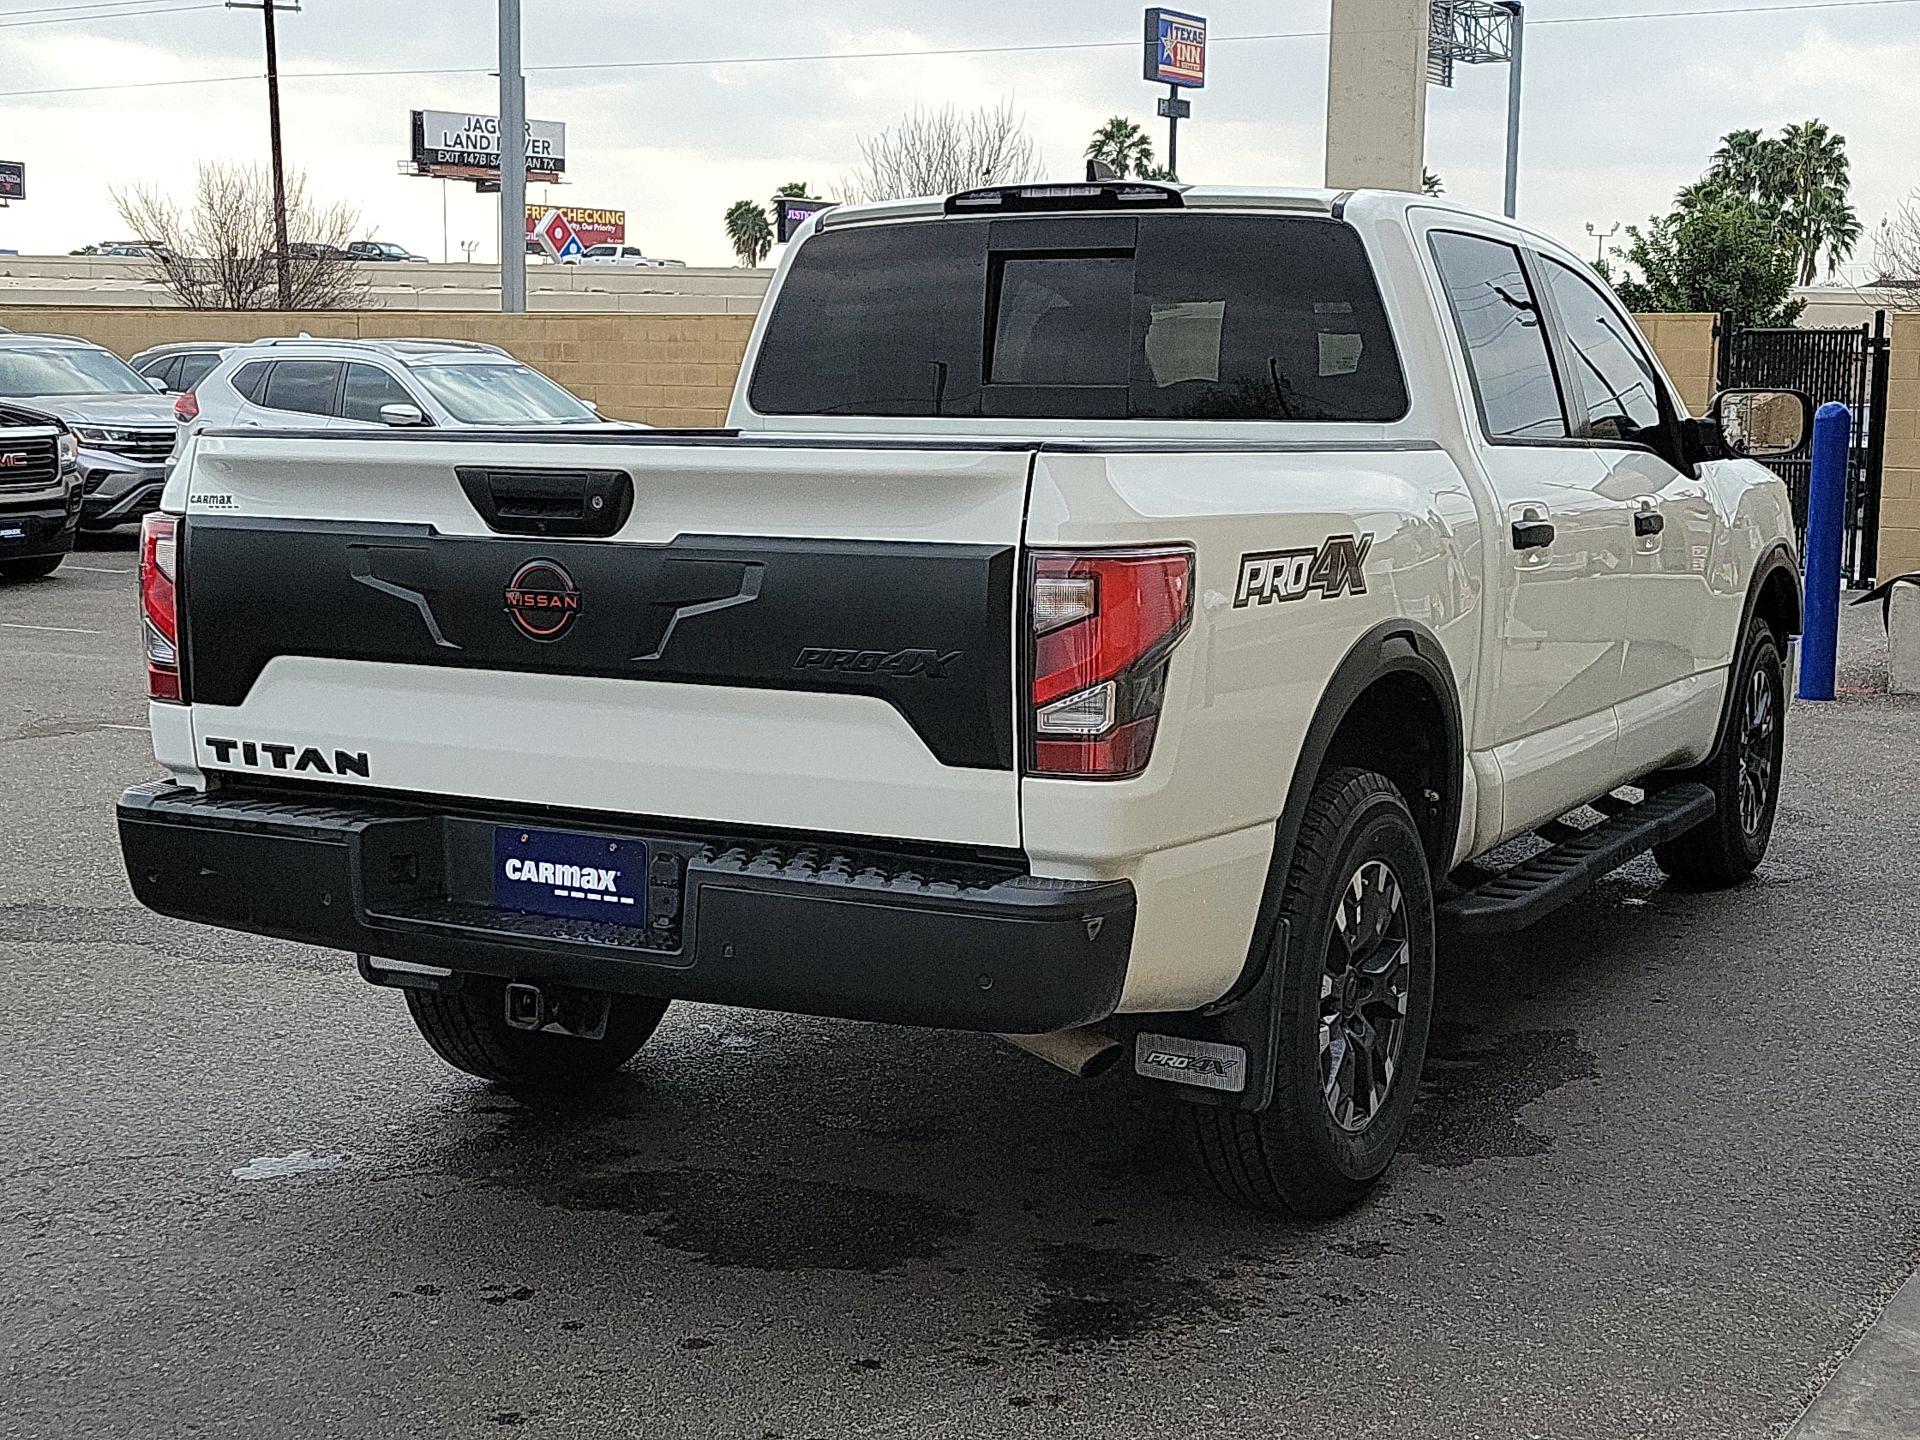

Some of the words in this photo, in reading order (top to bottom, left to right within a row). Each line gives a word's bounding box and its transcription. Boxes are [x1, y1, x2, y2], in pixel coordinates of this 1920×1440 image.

[1173, 26, 1203, 45] TEXAS
[1176, 42, 1201, 64] INN
[463, 116, 532, 138] JAGR
[443, 131, 491, 151] LAND
[437, 150, 460, 163] EXIT
[463, 152, 487, 165] 147B
[543, 159, 556, 169] TX
[525, 205, 548, 219] FRE
[560, 207, 624, 225] CHECKING
[506, 591, 577, 609] NISSAN
[205, 736, 370, 778] TITAN
